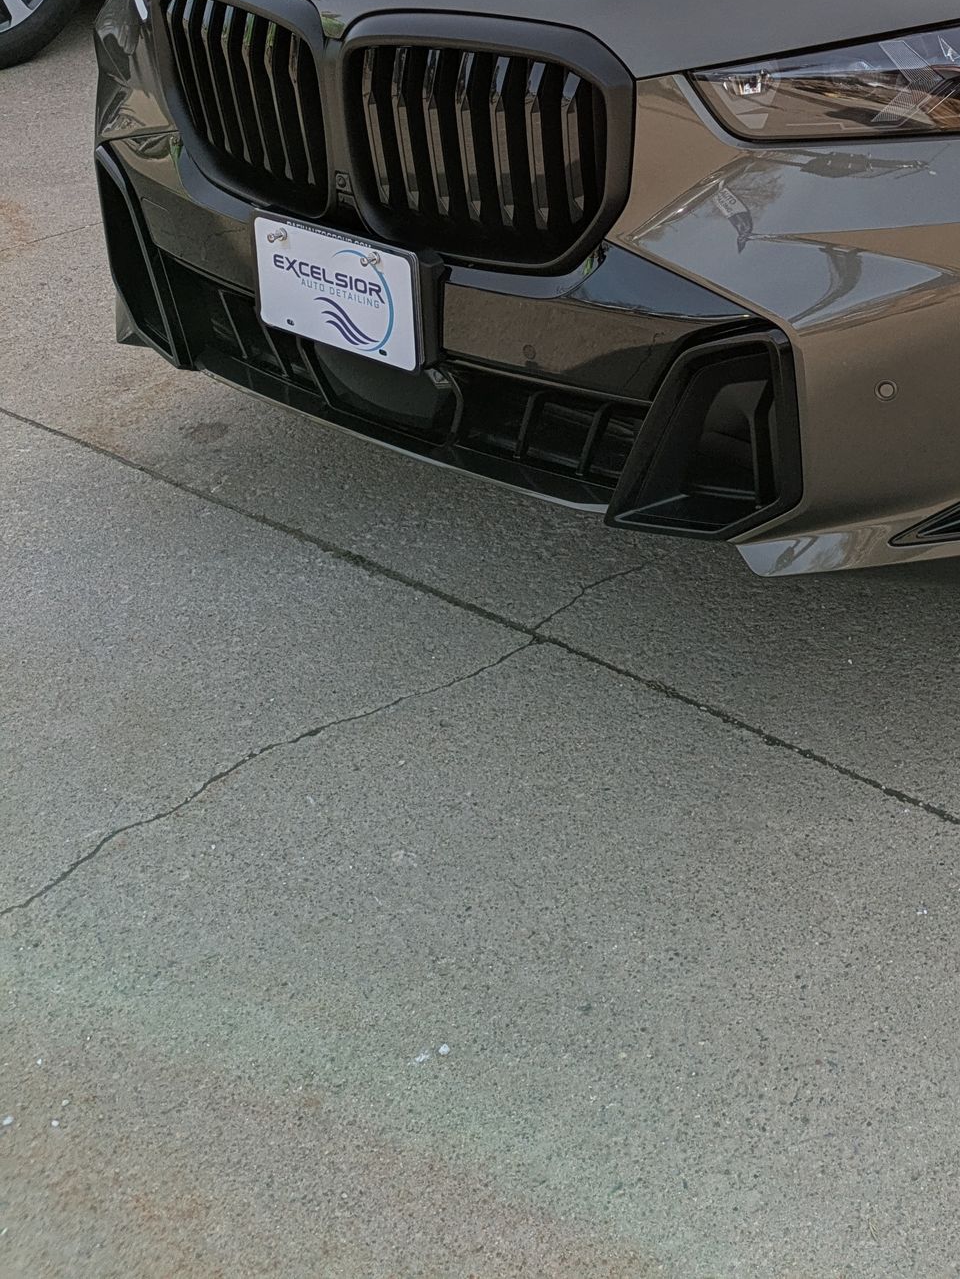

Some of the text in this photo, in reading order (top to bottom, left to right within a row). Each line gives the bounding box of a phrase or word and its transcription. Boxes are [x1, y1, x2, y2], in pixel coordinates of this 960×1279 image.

[273, 253, 385, 305] EXCELSIOR
[301, 278, 380, 309] AUTO DETAILING
